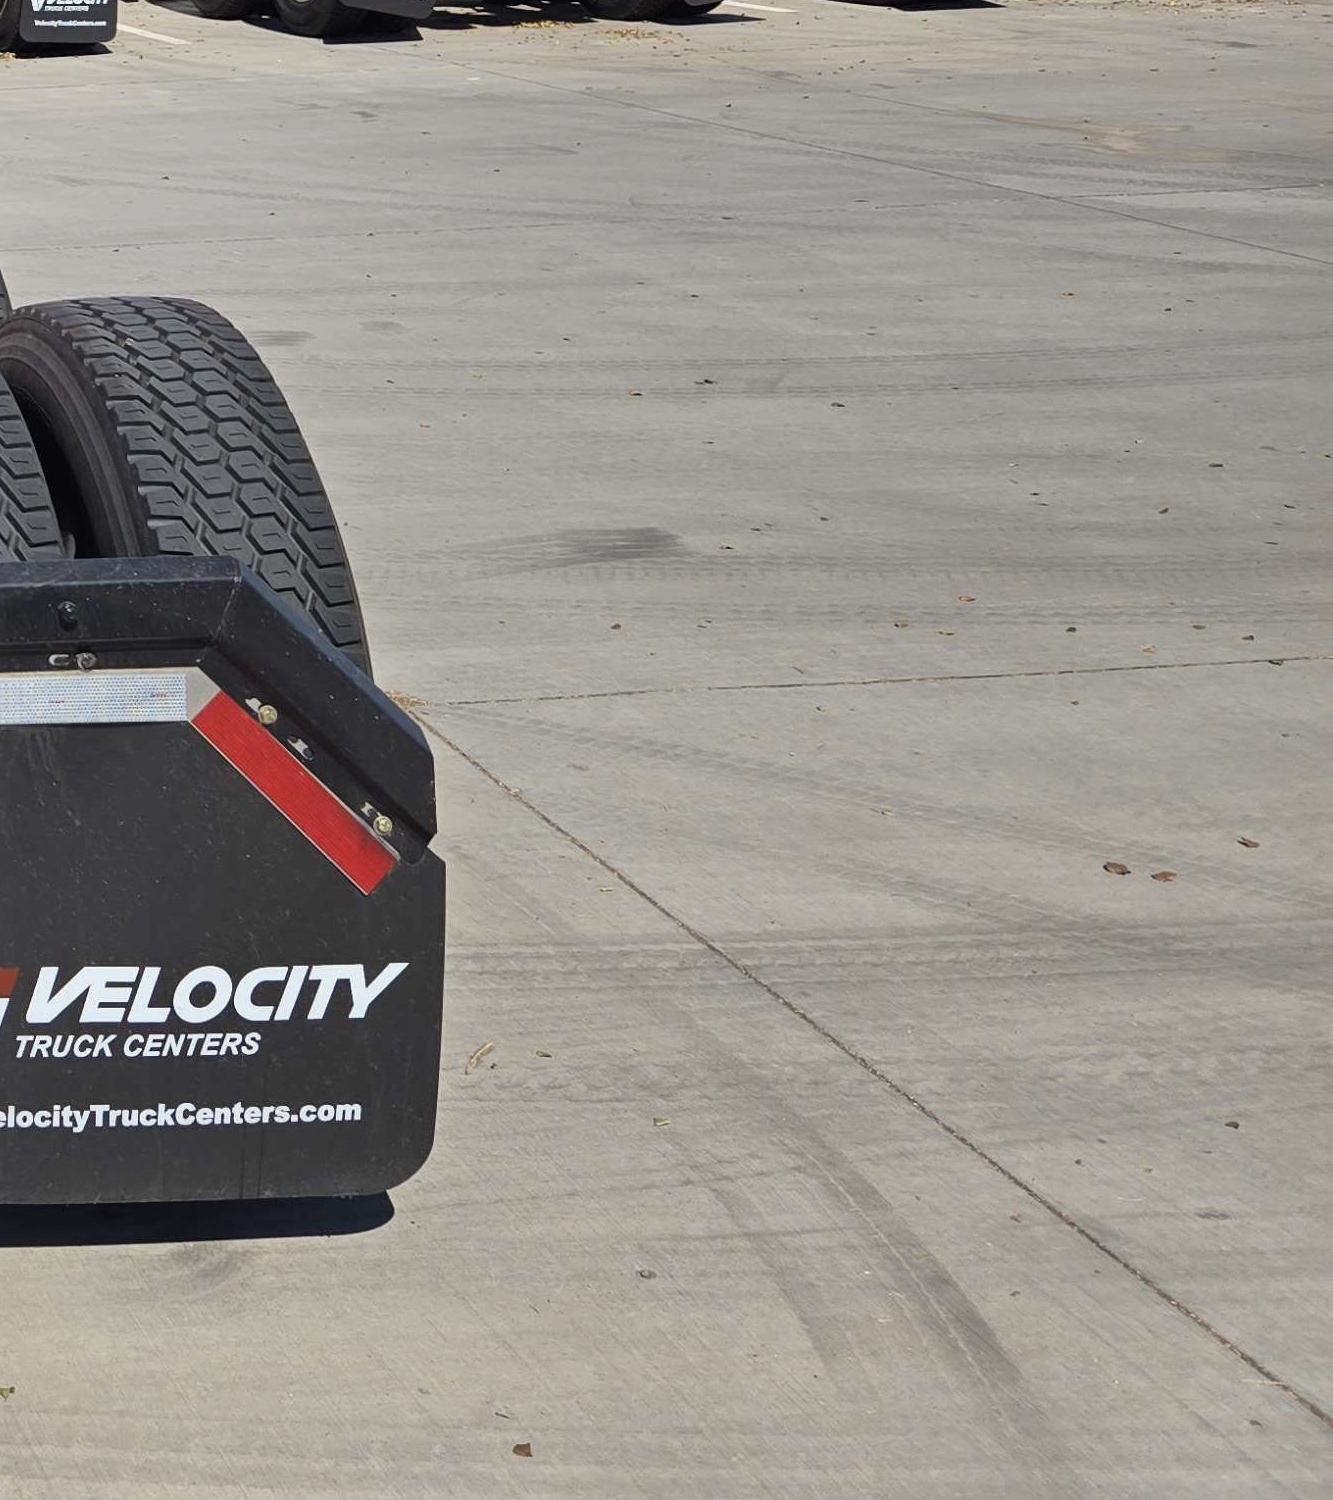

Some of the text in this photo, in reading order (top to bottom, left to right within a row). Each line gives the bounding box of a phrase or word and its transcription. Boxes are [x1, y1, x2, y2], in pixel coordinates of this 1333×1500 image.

[25, 962, 410, 1023] VELOCITY
[15, 1031, 262, 1059] TRUCK CENTERS
